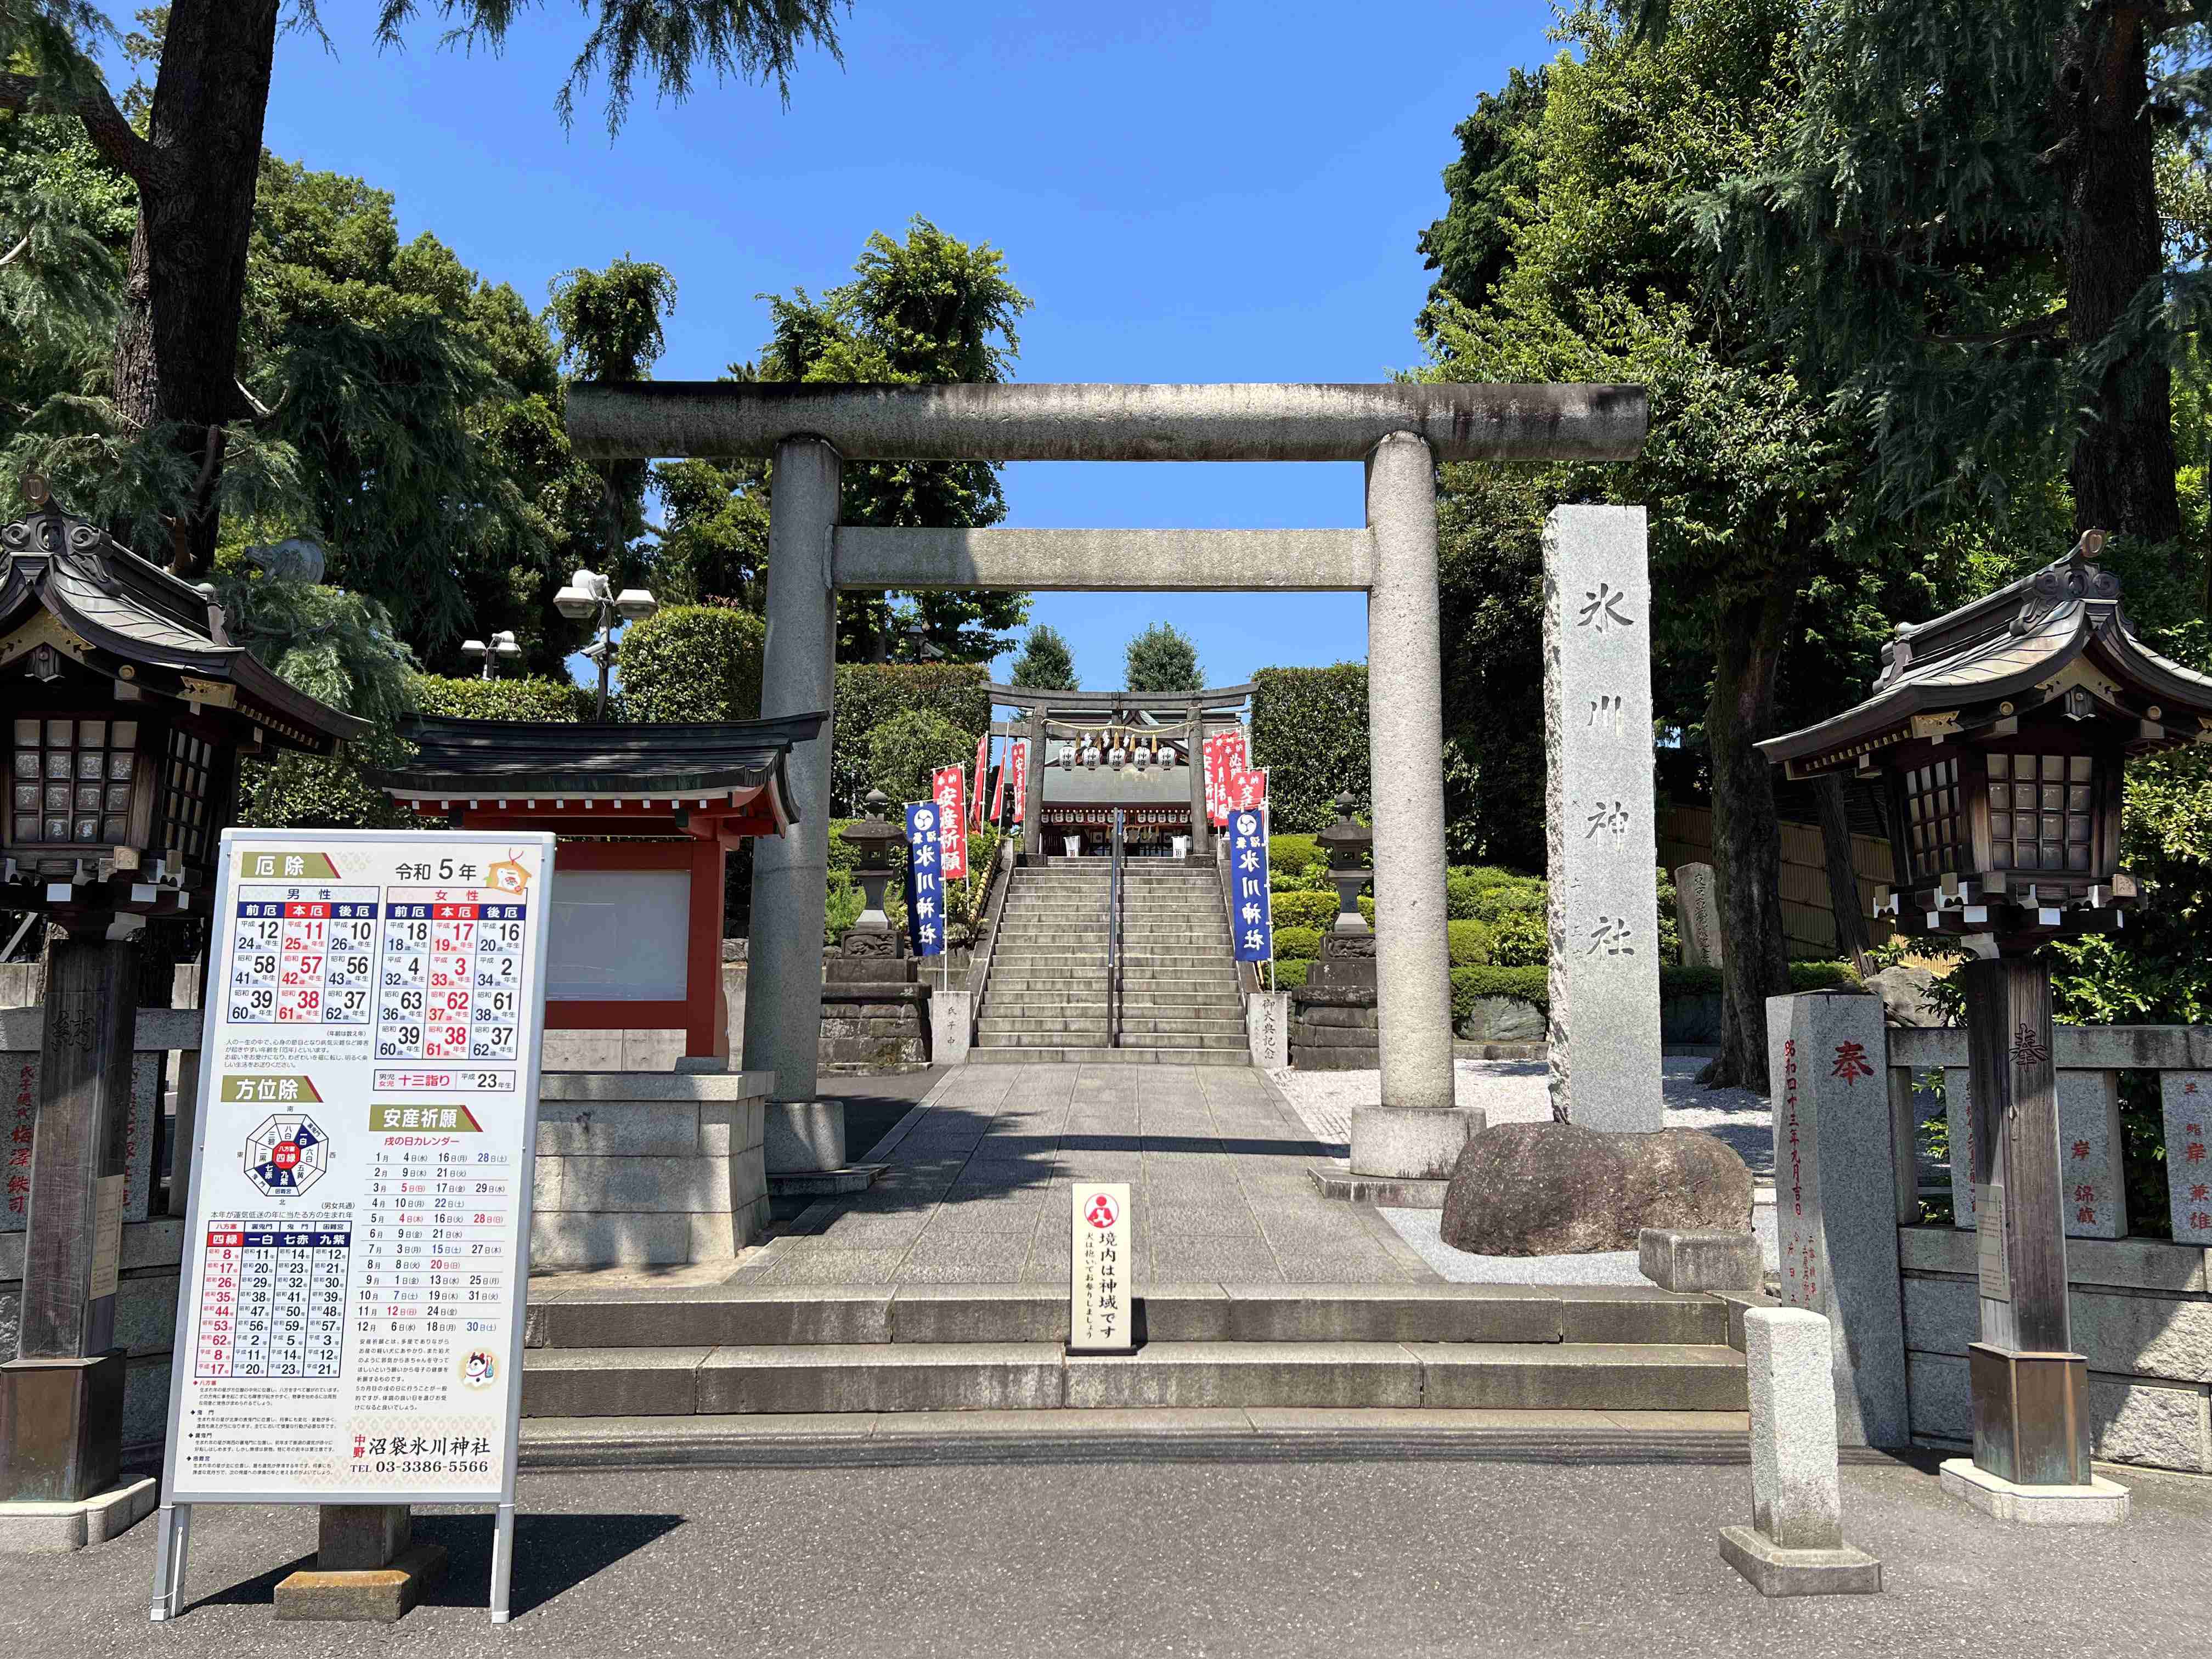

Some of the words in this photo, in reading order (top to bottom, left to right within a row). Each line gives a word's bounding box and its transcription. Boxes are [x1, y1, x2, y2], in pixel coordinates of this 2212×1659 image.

[1577, 582, 1635, 957] 氷川神社
[939, 786, 961, 870] 安産祈願
[255, 856, 304, 876] 厄除
[246, 905, 277, 916] 前厄
[292, 905, 324, 916] 本厄
[338, 905, 370, 917] 後厄
[394, 906, 426, 917] 前厄
[441, 906, 472, 918] 本厄
[487, 906, 518, 918] 後厄
[51, 1009, 95, 1053] 納
[947, 1006, 957, 1045] 氏子中
[1262, 998, 1276, 1059] 御大典記念
[2009, 1023, 2050, 1073] 奉
[1830, 1040, 1875, 1087] 奉
[236, 1079, 298, 1100] 方位除
[398, 1074, 450, 1086] 十三詣り
[383, 1108, 458, 1128] 安産祈願
[1784, 1039, 1803, 1216] 昭和四十三年九月吉日
[385, 1137, 459, 1146] 戌の日カレンダー
[248, 1235, 273, 1245] 一白
[284, 1234, 309, 1245] 七赤
[319, 1235, 345, 1245] 九紫
[1099, 1232, 1118, 1339] 境内は神域です
[353, 1434, 365, 1458] 中野
[369, 1436, 491, 1457] 沼袋氷川神社
[351, 1464, 372, 1473] TEL
[376, 1461, 488, 1473] 03-3386-5566
